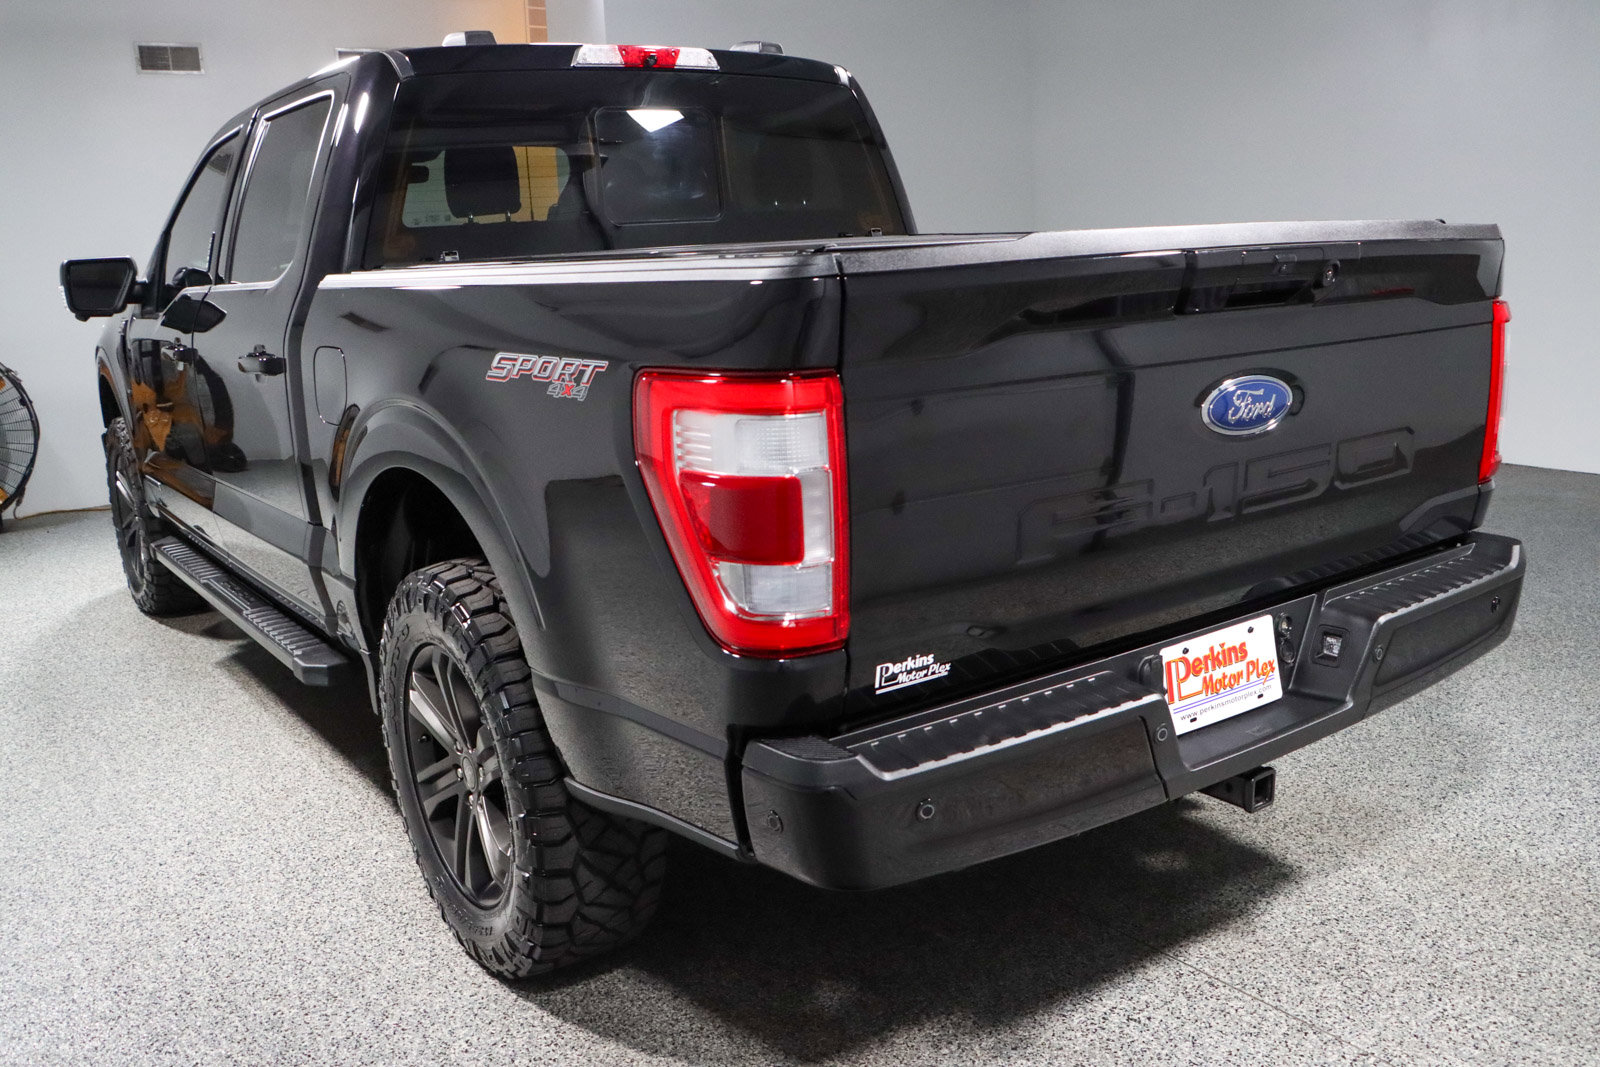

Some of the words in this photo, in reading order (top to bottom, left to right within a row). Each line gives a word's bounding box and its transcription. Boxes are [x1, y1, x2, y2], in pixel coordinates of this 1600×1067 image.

[486, 352, 609, 386] SPORT
[1227, 388, 1276, 424] Ford
[1016, 426, 1415, 564] F-150
[875, 654, 934, 689] Perkins
[898, 669, 927, 684] Motor
[928, 662, 951, 676] Plex
[1165, 641, 1248, 705] Perkins
[1201, 669, 1244, 696] Motor
[1246, 658, 1276, 685] Plex
[1180, 684, 1272, 721] www.perkinsmotorplex.com
